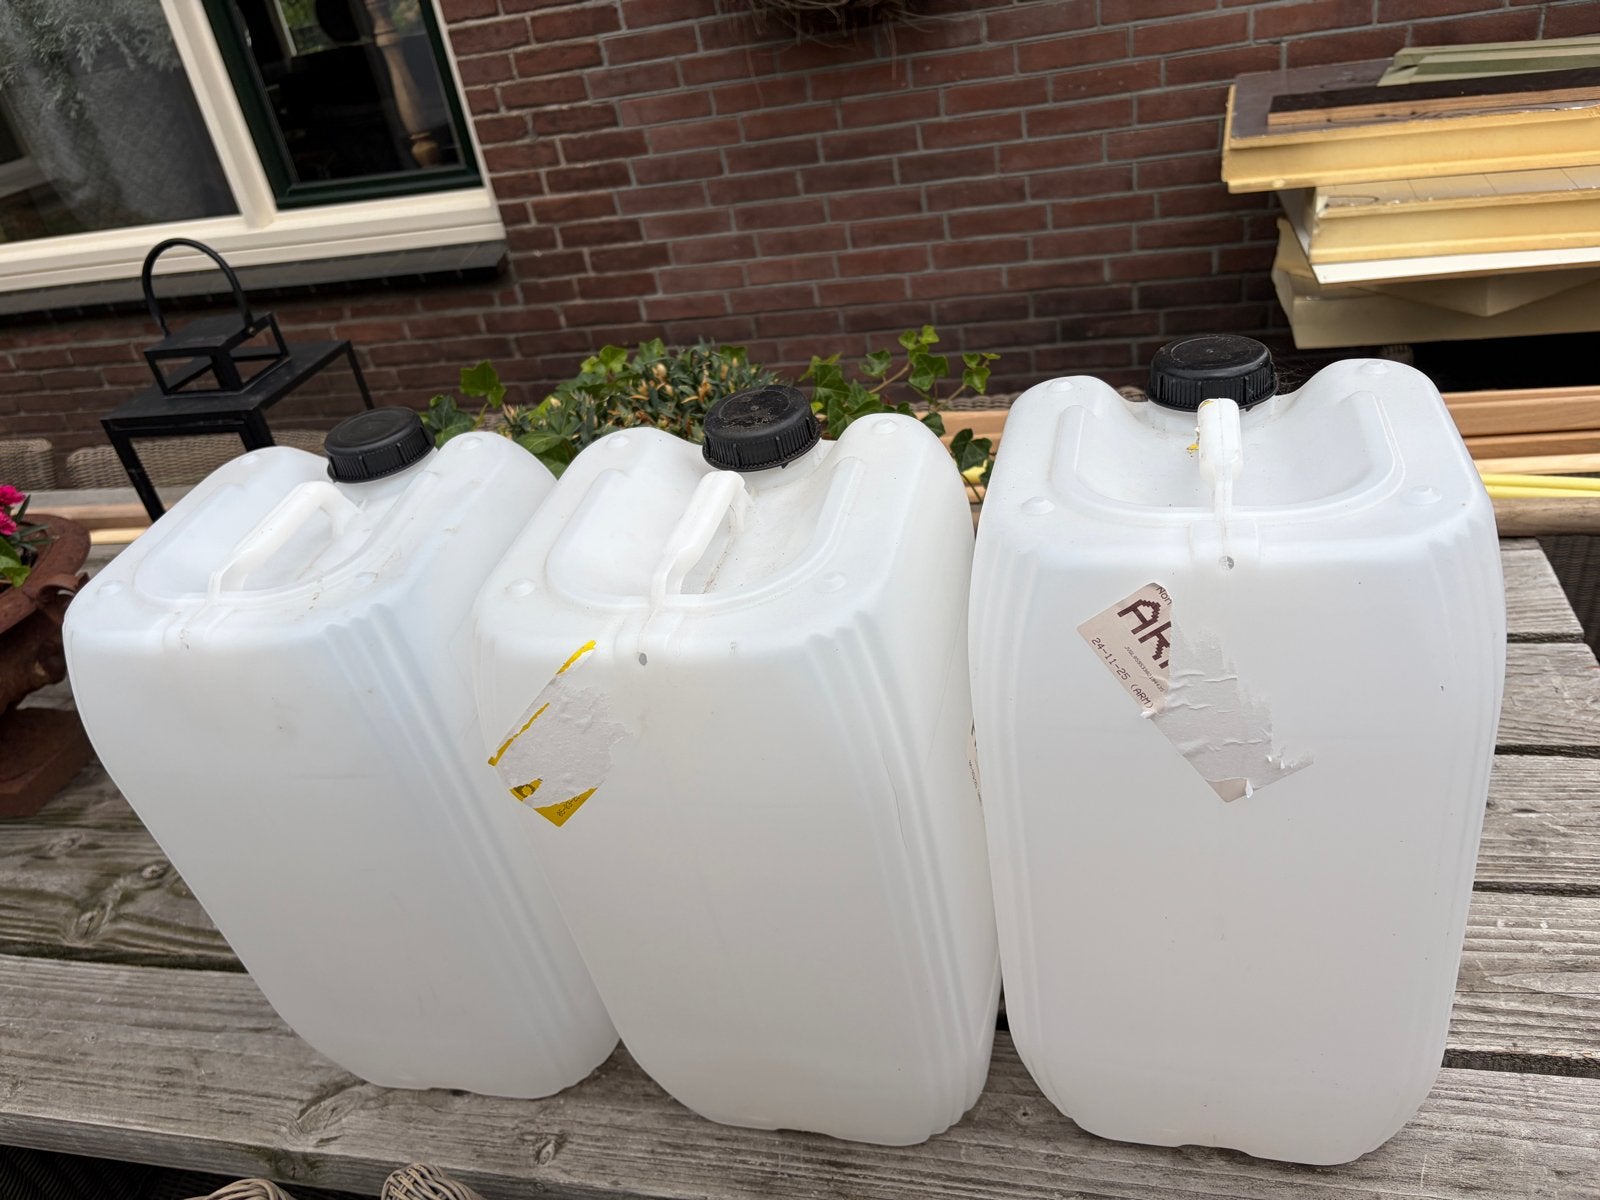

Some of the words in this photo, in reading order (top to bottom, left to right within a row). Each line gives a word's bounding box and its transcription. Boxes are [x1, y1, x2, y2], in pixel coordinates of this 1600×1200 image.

[1117, 599, 1171, 669] AK
[1091, 637, 1131, 680] 24-11-25
[1130, 684, 1154, 709] (ARM)
